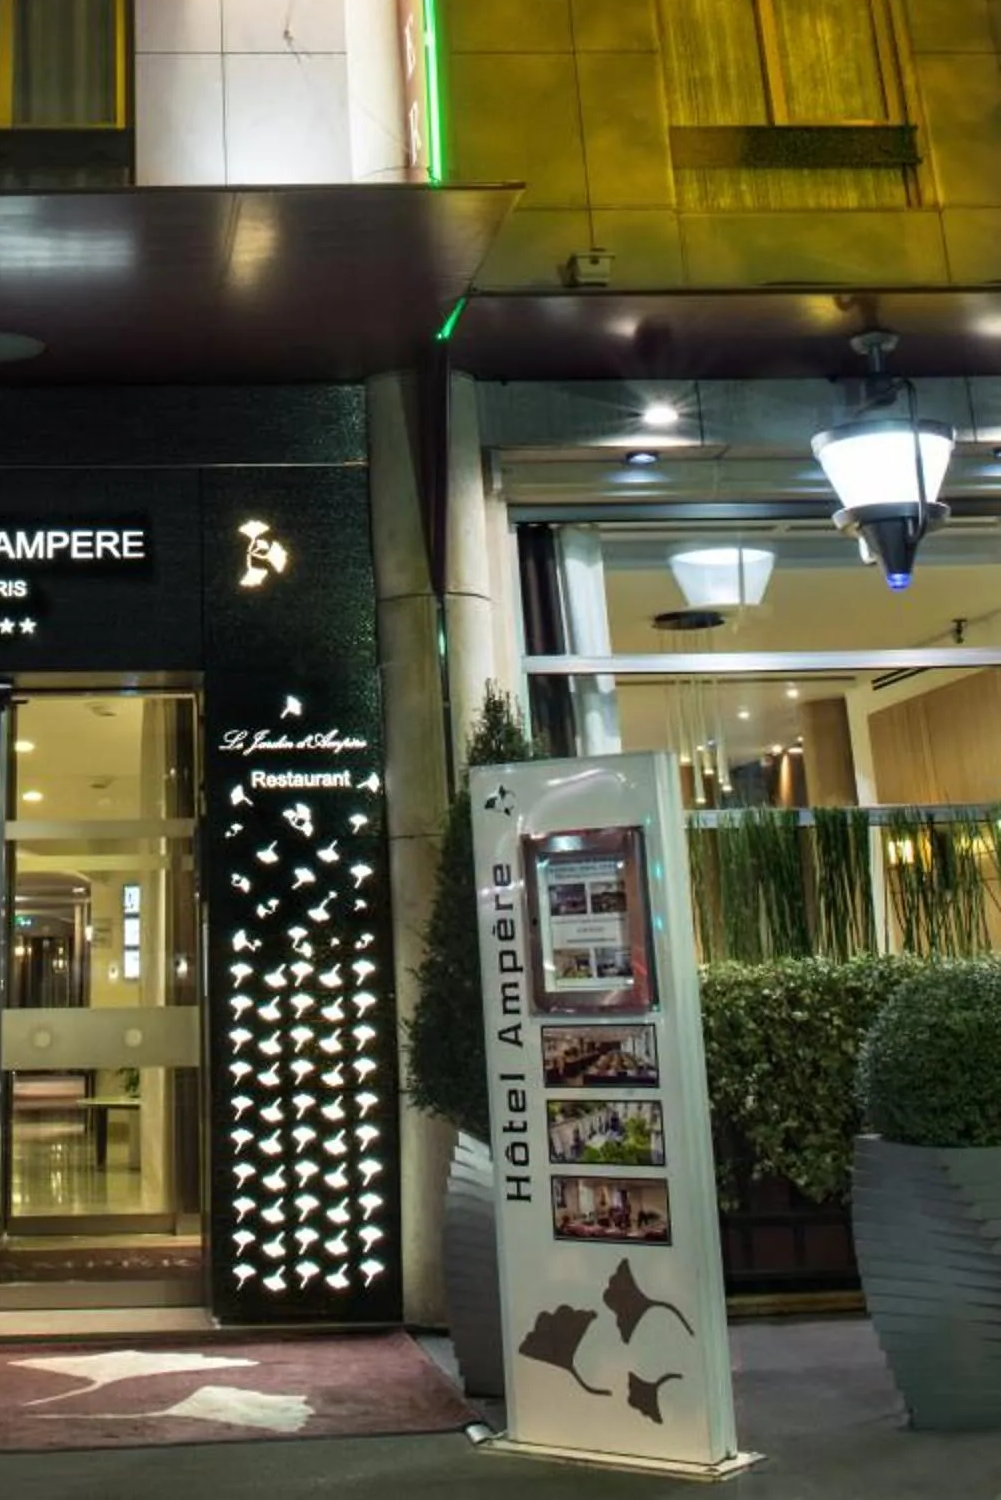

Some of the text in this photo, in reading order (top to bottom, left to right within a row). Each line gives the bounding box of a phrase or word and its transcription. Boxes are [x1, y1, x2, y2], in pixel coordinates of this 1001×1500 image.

[218, 729, 248, 750] Le
[250, 769, 352, 789] Restaurant
[491, 862, 532, 1203] Hôtel Ampère
